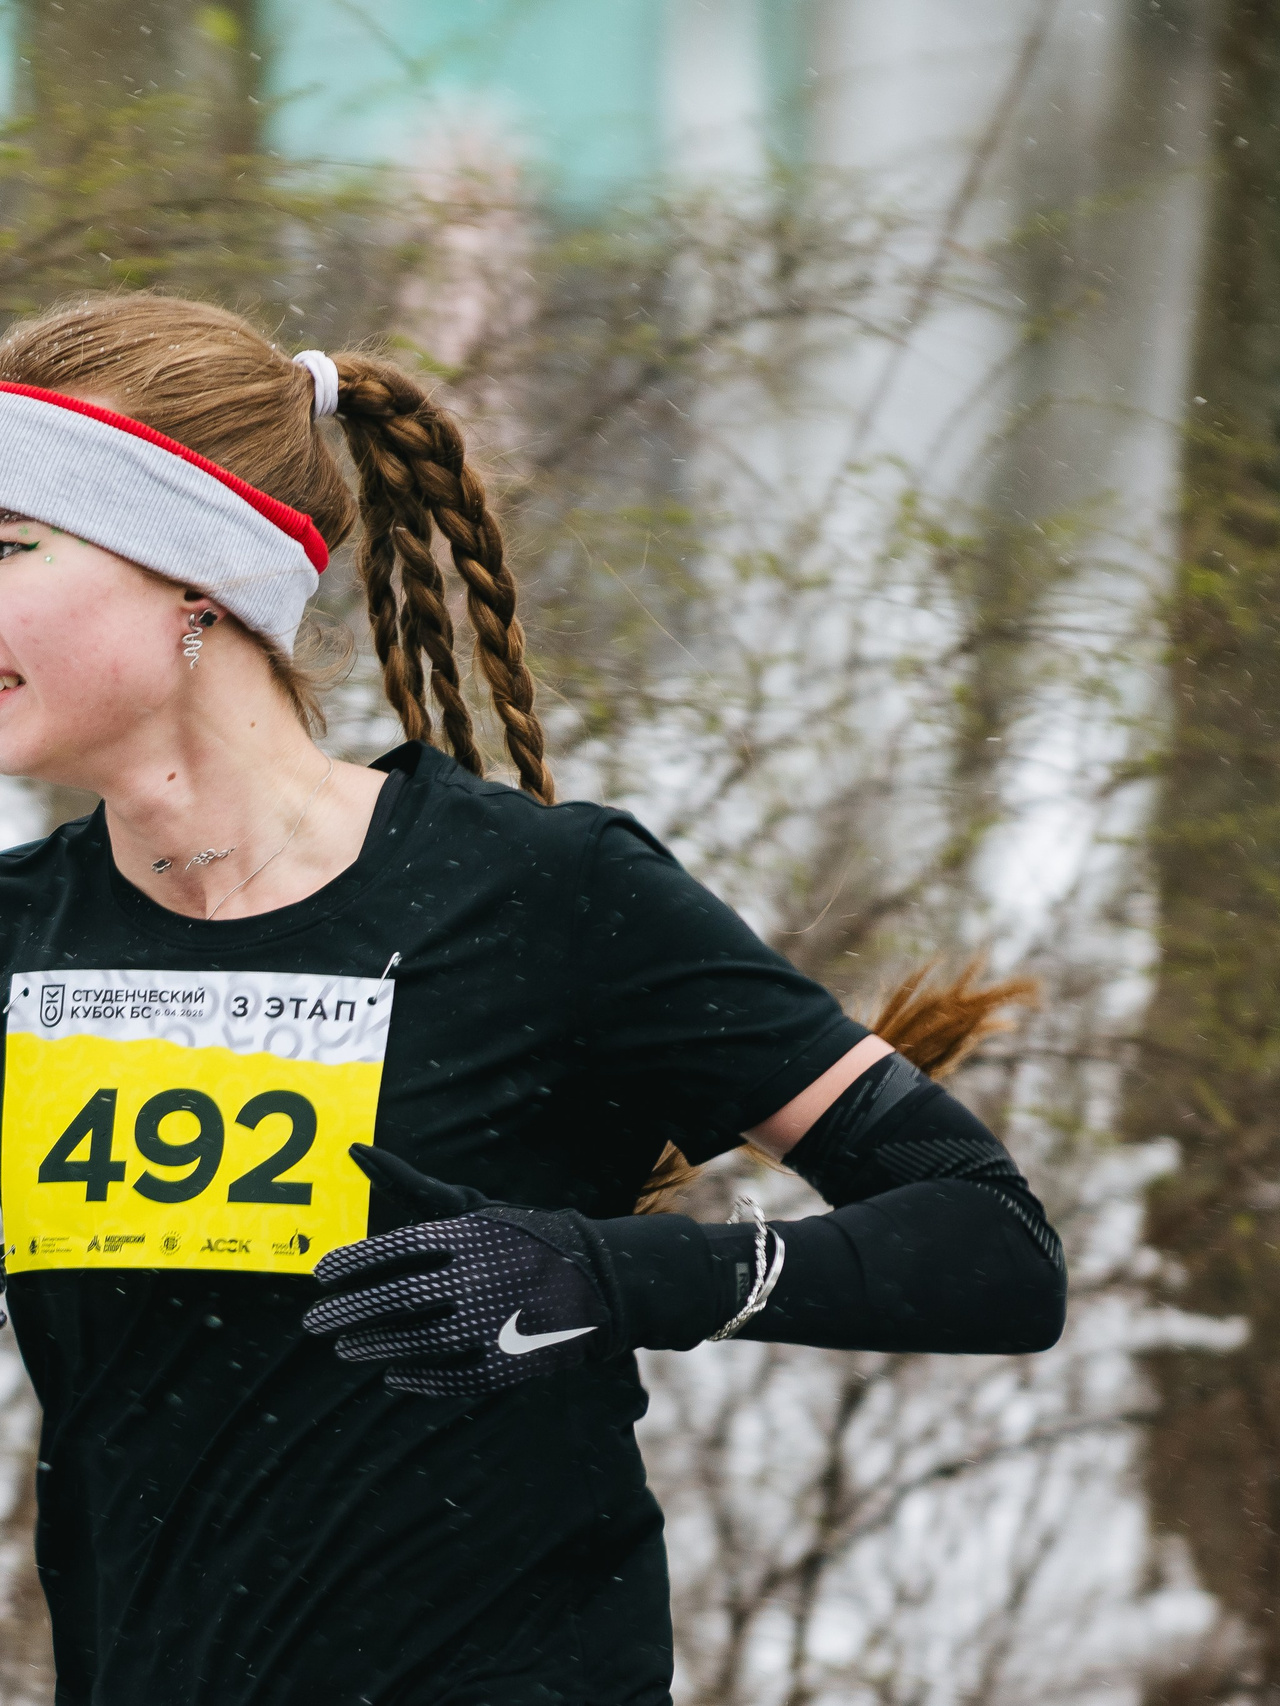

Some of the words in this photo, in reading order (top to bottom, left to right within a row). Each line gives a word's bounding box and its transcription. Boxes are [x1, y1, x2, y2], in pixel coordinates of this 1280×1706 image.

[71, 987, 206, 1004] СТУДЕНЧЕСКИЙ
[70, 1005, 125, 1019] КУБОК
[129, 1005, 152, 1019] БС
[232, 995, 249, 1018] 3
[264, 996, 357, 1022] ЭТАП
[37, 1087, 318, 1206] 492
